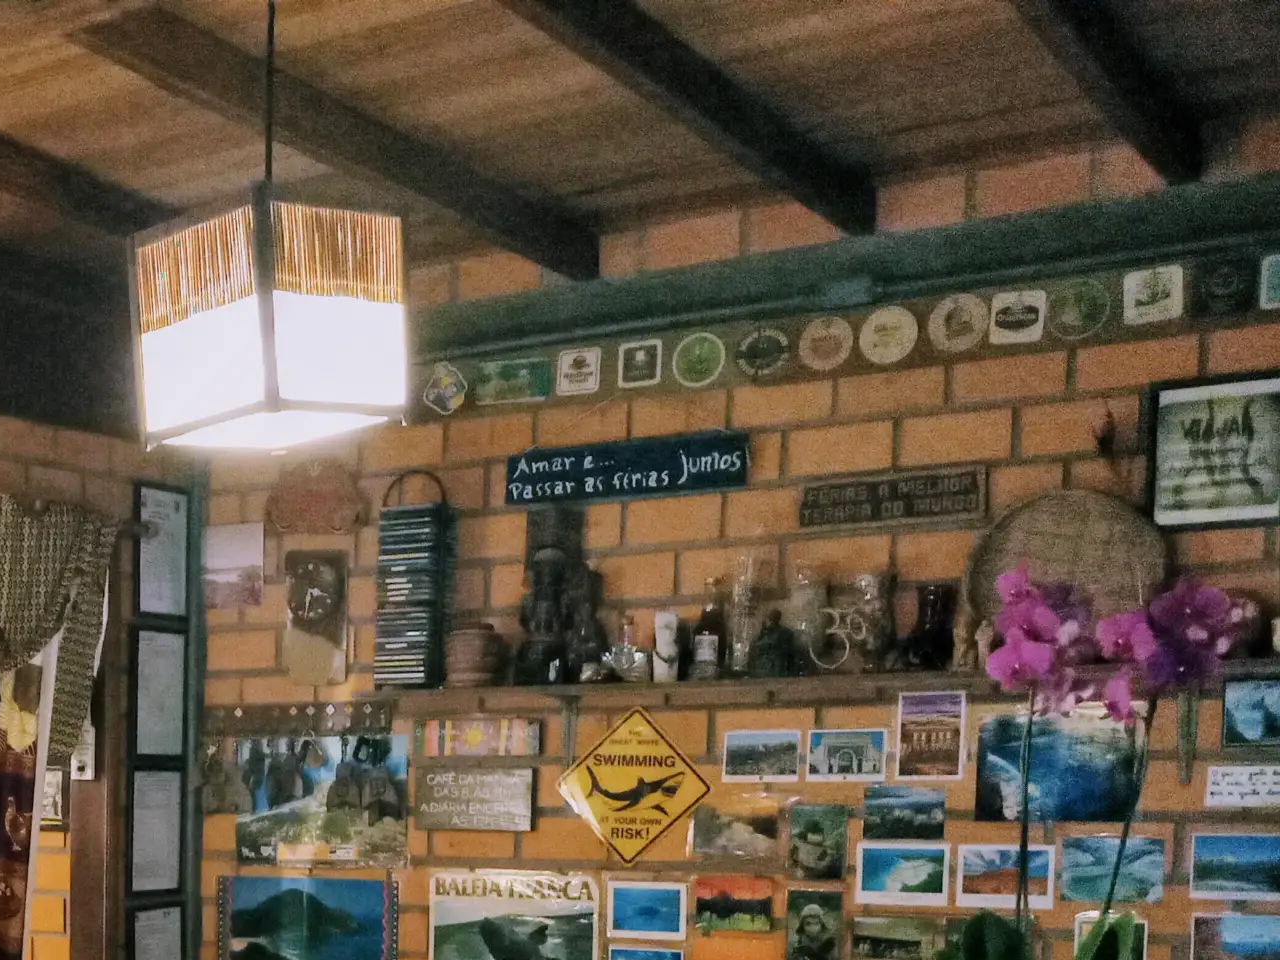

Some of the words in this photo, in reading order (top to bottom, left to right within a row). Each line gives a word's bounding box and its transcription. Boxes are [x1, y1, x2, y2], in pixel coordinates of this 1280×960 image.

[513, 456, 576, 478] Amar
[508, 479, 576, 501] Passar
[584, 475, 604, 494] as
[612, 466, 670, 491] férias
[593, 753, 677, 768] SWIMMING
[433, 786, 459, 799] DAS
[613, 815, 638, 826] YOUR
[639, 817, 663, 827] OWN
[610, 826, 651, 841] RISK!
[435, 877, 504, 898] BALEIA
